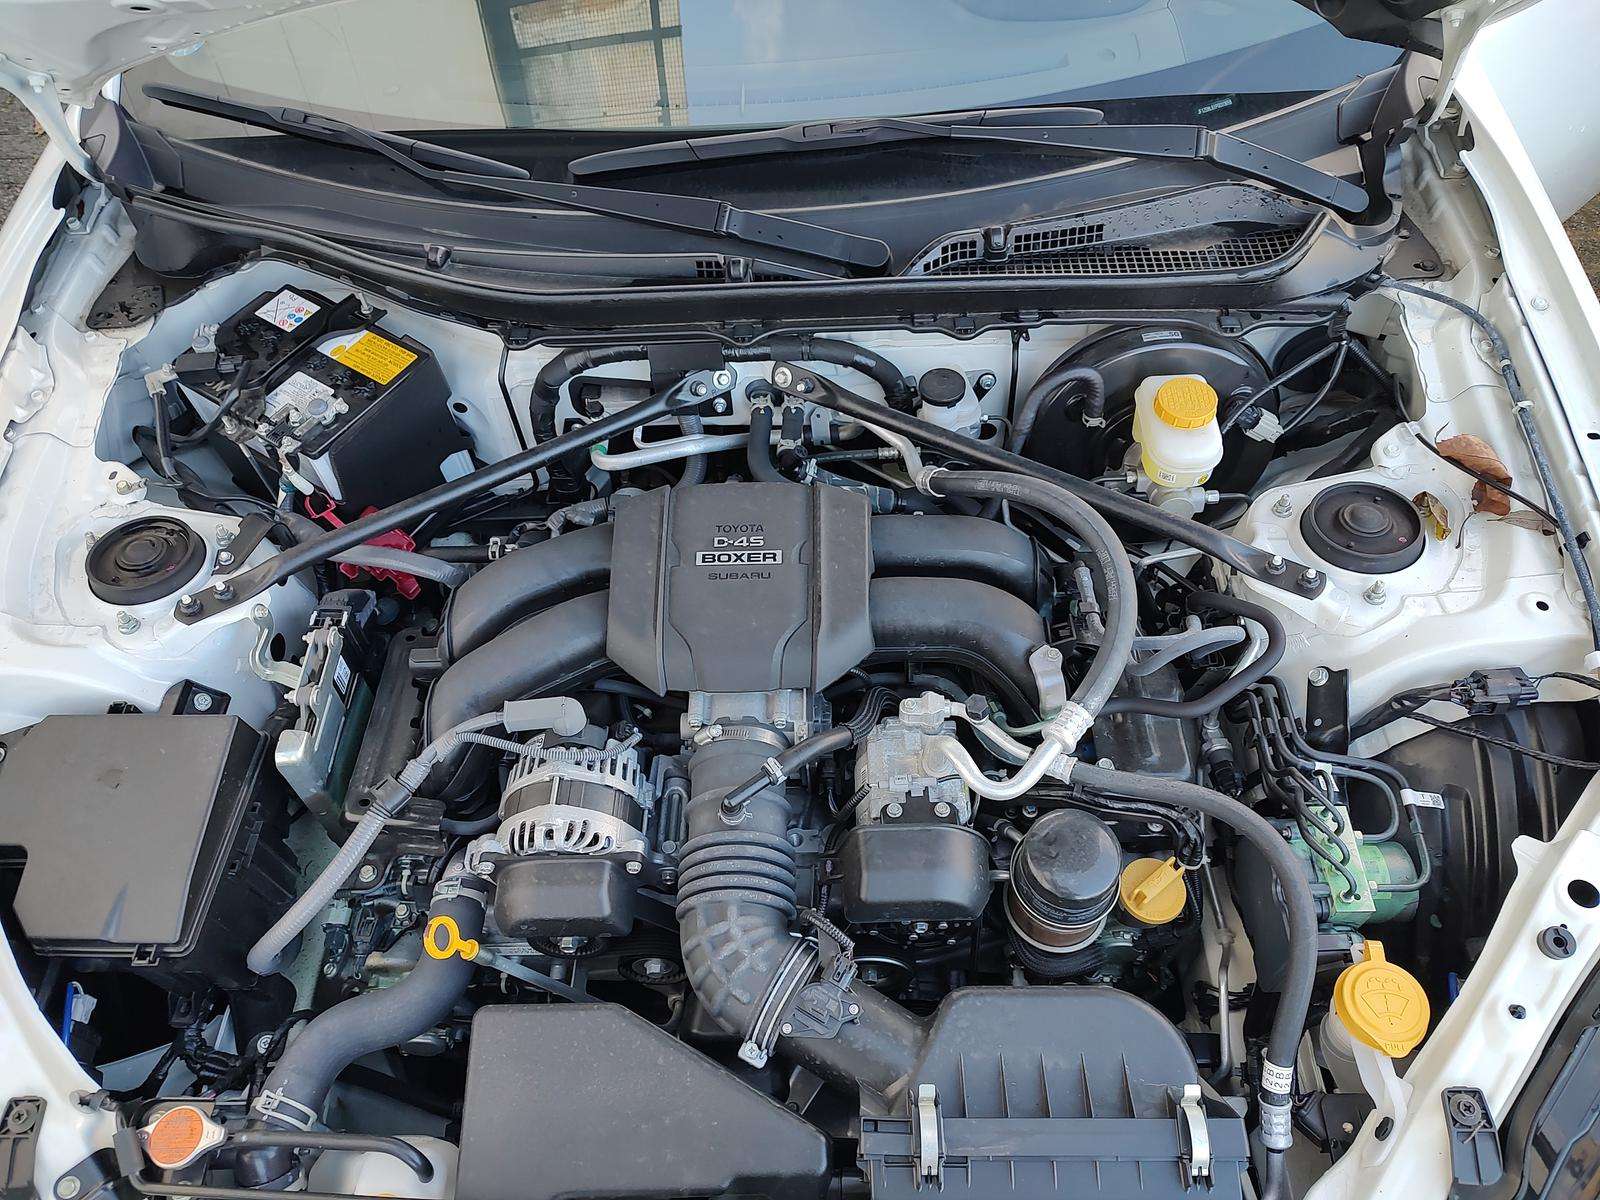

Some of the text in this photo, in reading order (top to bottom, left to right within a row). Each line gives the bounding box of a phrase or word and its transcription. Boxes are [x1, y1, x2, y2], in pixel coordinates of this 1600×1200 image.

[715, 524, 765, 534] TOYOTA
[713, 536, 765, 548] D-4S
[700, 551, 778, 564] BOXER
[707, 571, 772, 580] SUBARU
